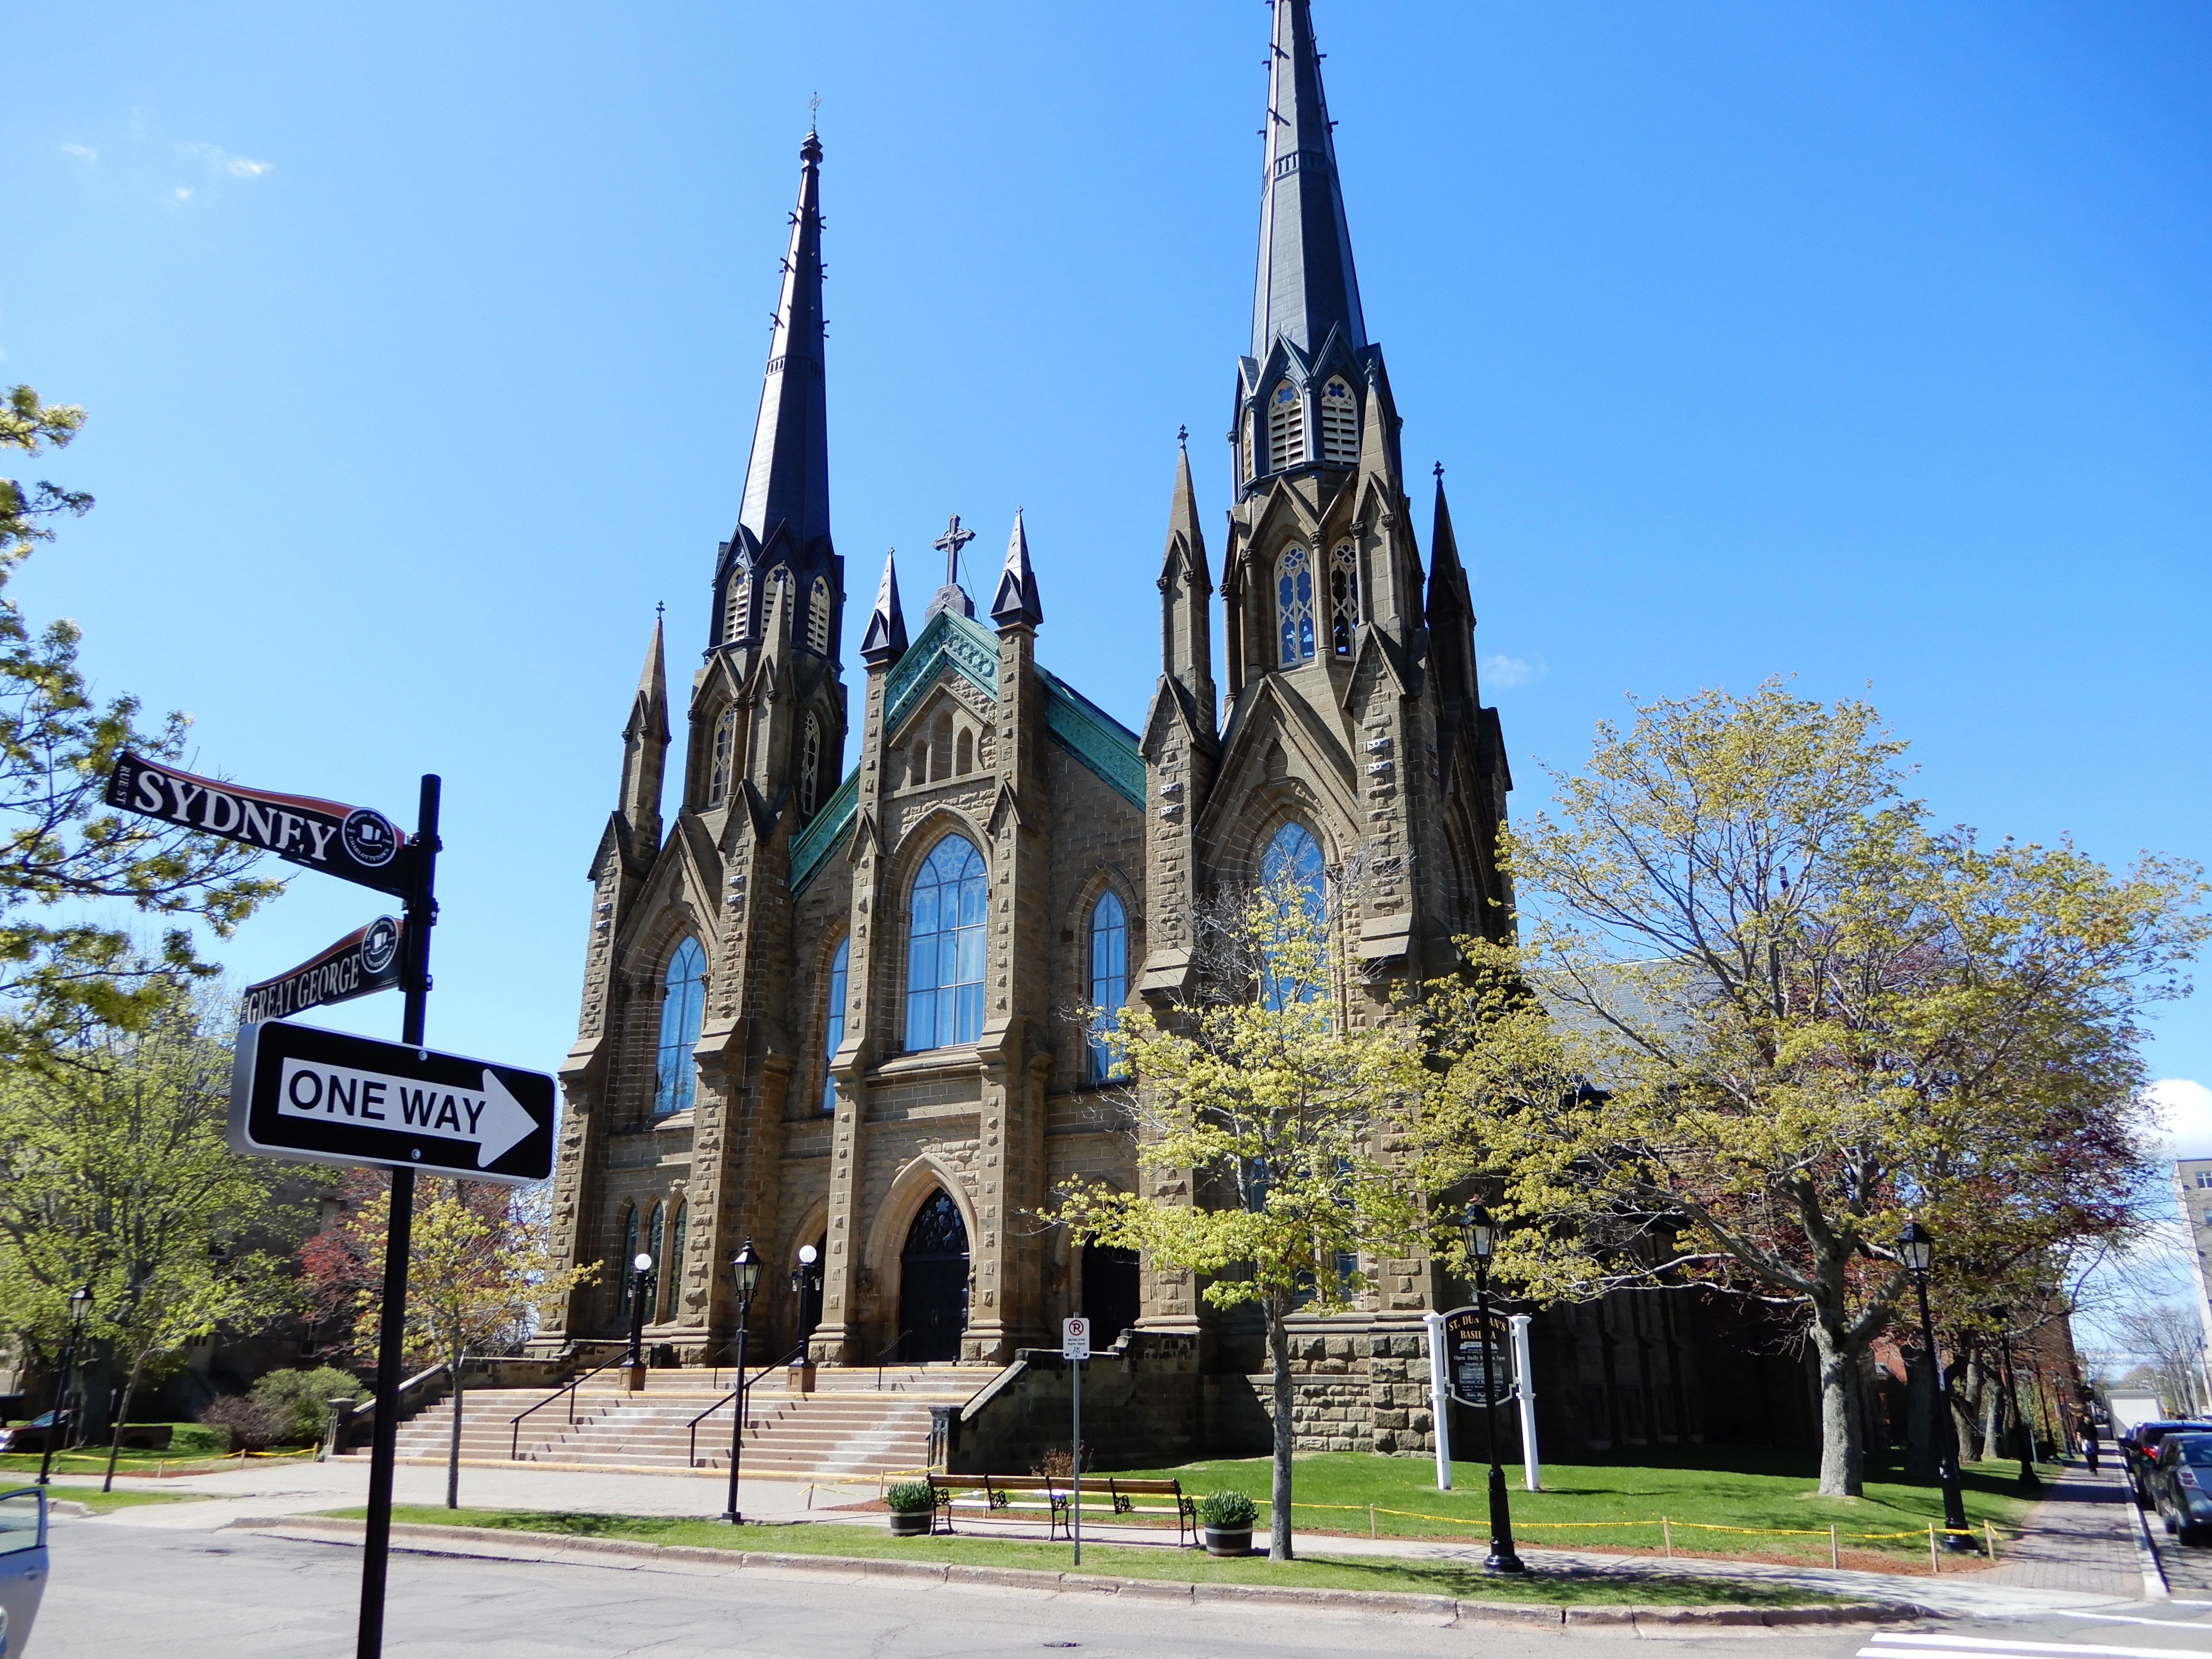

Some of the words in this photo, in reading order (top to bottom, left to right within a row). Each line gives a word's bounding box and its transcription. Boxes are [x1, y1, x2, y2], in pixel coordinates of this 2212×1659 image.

[134, 771, 337, 861] SYDNEY
[349, 836, 390, 861] CHARLOTTETOWN
[247, 978, 296, 1024] GREAT
[297, 954, 360, 1008] GEORGE
[289, 1070, 387, 1121] ONE
[400, 1086, 486, 1135] WAY
[1449, 1319, 1460, 1331] ST.
[1462, 1315, 1506, 1331] DUNAN'S
